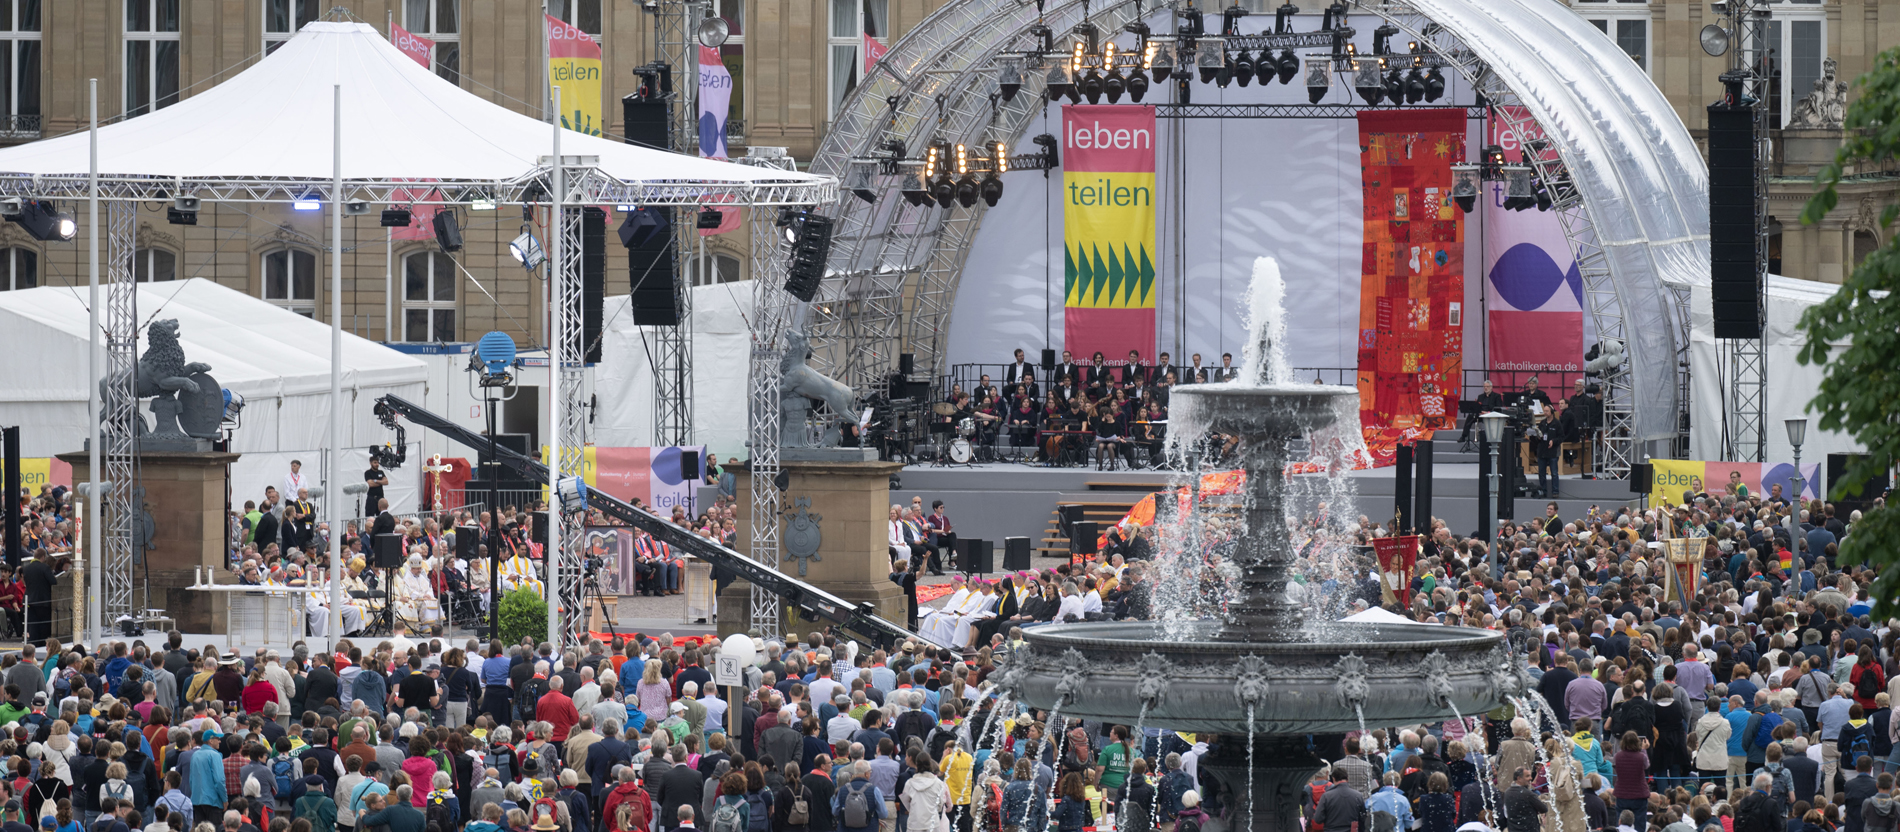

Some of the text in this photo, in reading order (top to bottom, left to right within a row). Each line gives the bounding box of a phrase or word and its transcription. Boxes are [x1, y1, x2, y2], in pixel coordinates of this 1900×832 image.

[548, 21, 594, 42] lebe
[553, 61, 599, 81] teilen
[1068, 120, 1150, 149] leben
[1068, 178, 1150, 207] teilen
